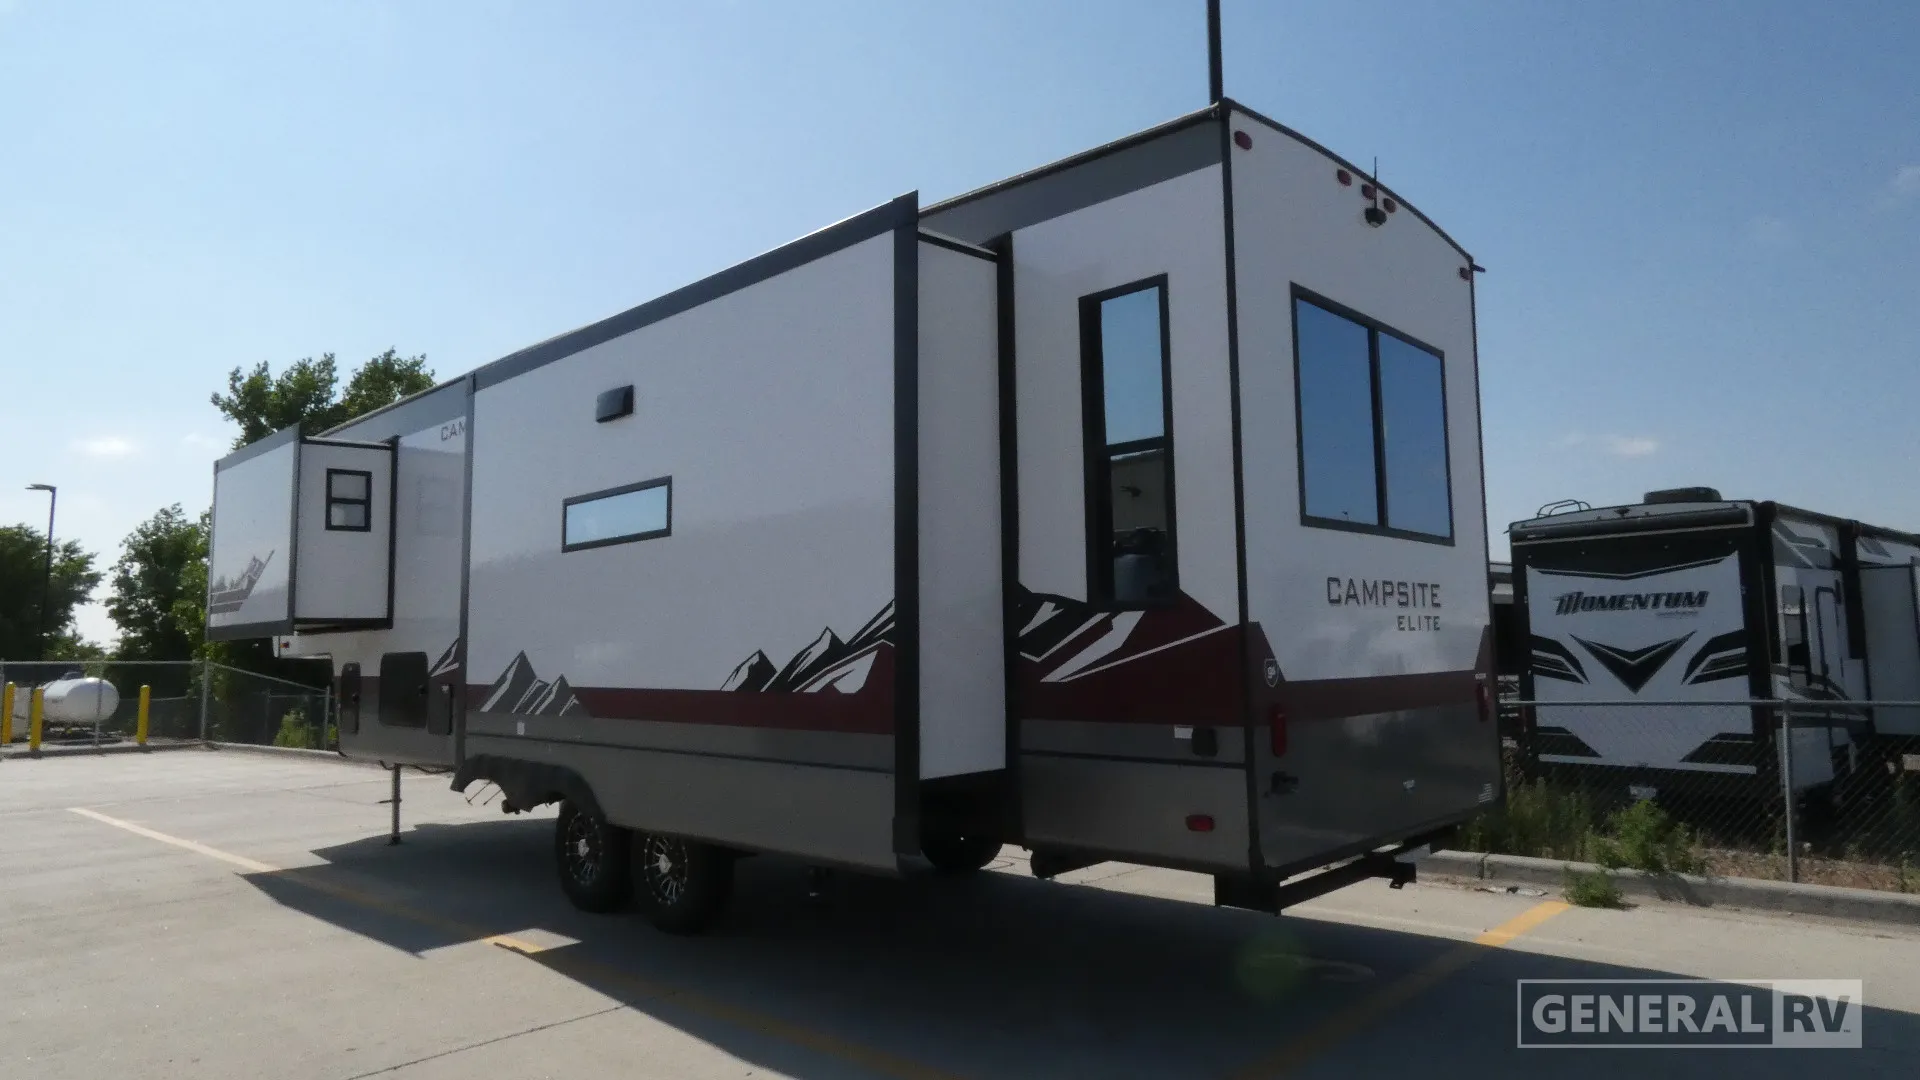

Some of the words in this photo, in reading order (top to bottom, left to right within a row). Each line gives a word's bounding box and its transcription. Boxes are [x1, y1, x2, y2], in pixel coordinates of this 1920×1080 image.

[1327, 577, 1441, 608] CAMPSITE
[1555, 591, 1709, 616] MOMENTUM
[1397, 615, 1441, 632] ELITE
